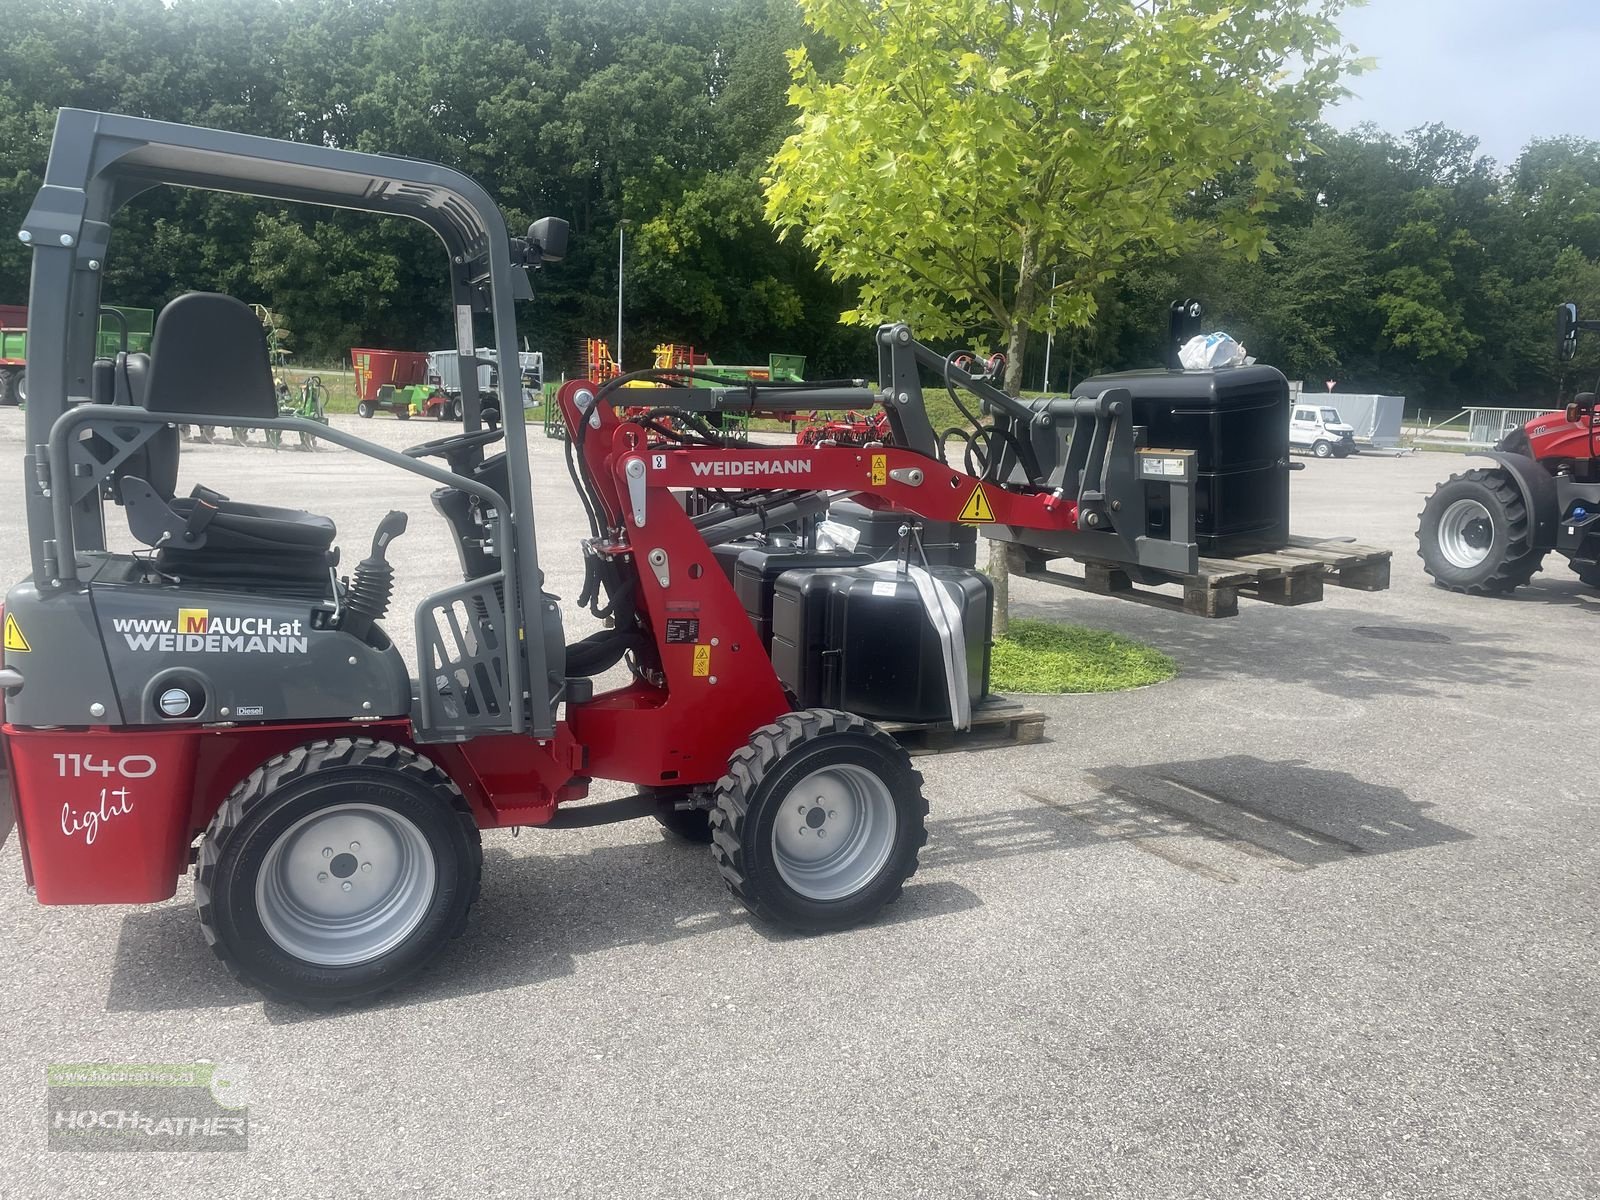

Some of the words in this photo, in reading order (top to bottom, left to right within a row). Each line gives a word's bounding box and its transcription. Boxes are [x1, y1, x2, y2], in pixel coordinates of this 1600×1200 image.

[690, 459, 812, 476] WEIDEMANN
[113, 616, 302, 636] www.MAUCH.at
[124, 633, 308, 653] WEIDEMANN
[238, 706, 262, 714] Diesel
[53, 753, 157, 778] 1140
[61, 786, 134, 845] light
